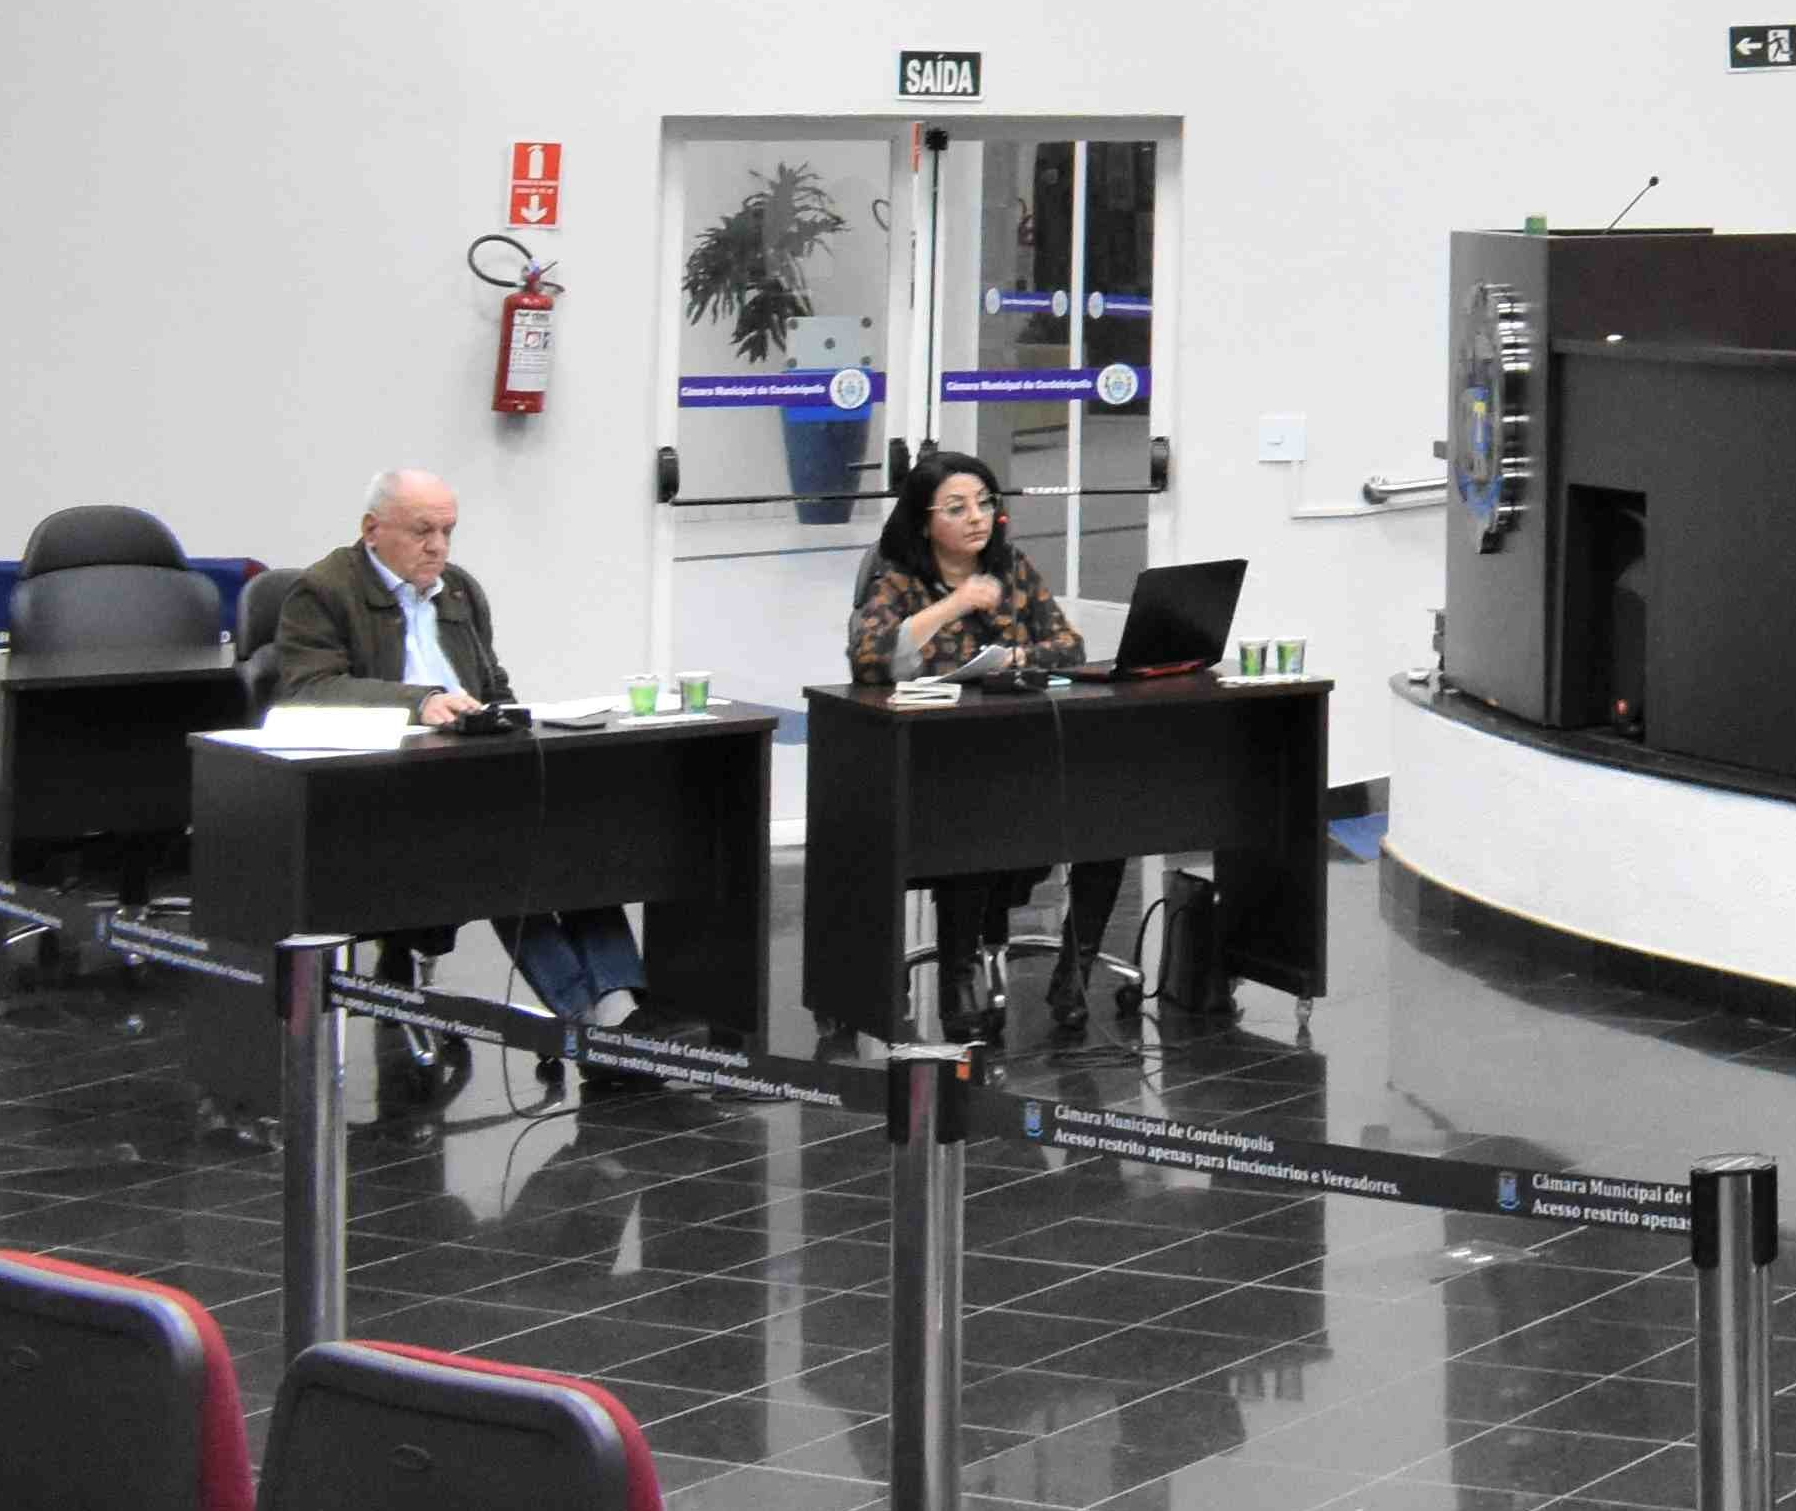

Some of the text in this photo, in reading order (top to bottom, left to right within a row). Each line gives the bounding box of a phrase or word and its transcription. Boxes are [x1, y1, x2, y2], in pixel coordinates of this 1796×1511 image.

[906, 54, 974, 93] SAÍDA
[587, 1027, 621, 1045] Câmara
[623, 1033, 669, 1055] Municipal
[670, 1041, 683, 1055] de
[1054, 1103, 1276, 1154] Câmara Municipal de Cordeirópolis
[1053, 1127, 1402, 1196] Acesso restrito apenas para funcionários e Vereadores.
[1532, 1172, 1587, 1195] Câmara
[1589, 1178, 1662, 1204] Municipal
[1664, 1186, 1684, 1204] de
[1532, 1197, 1582, 1220] Acesso
[1583, 1204, 1640, 1225] restrito
